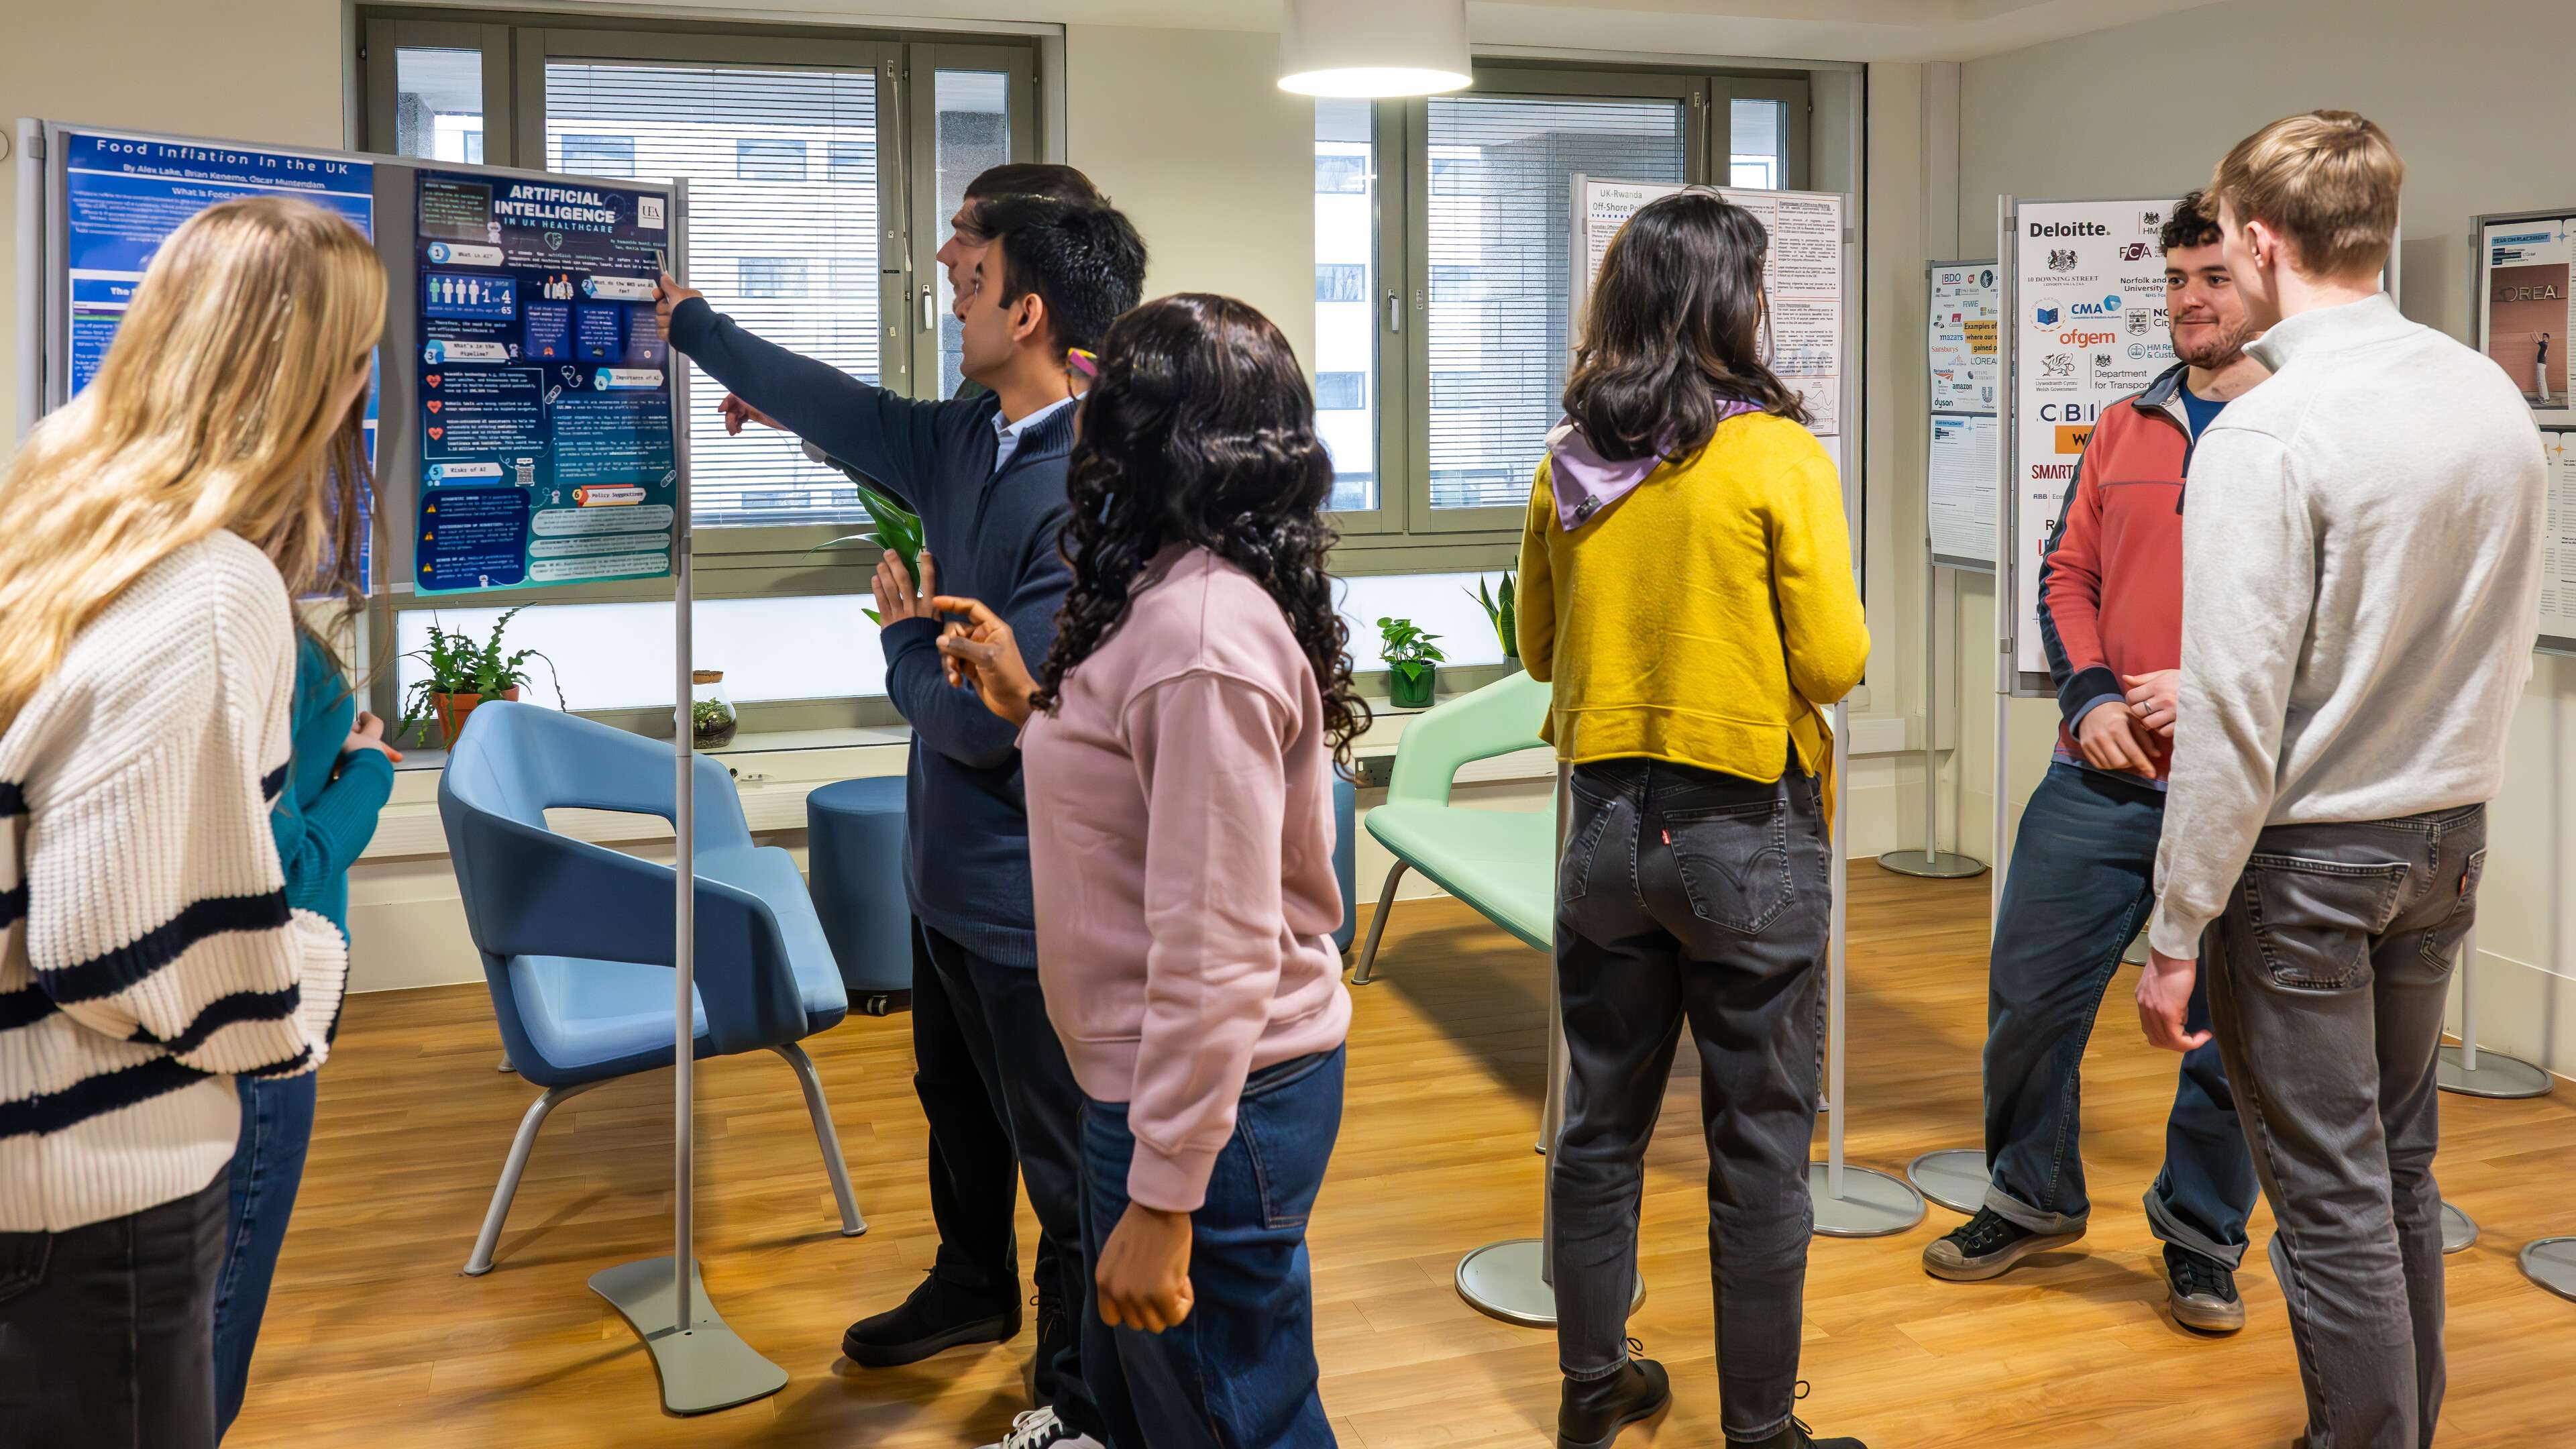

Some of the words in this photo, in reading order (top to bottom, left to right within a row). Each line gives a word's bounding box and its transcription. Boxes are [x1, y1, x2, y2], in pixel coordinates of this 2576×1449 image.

[97, 140, 148, 155] Food
[159, 146, 249, 165] Inflation
[260, 156, 276, 168] In
[286, 159, 316, 172] the
[326, 162, 348, 175] UK
[123, 163, 135, 174] By
[249, 175, 273, 184] Oscar
[172, 186, 197, 197] What
[509, 184, 602, 207] ARTIFICIAL
[1600, 189, 1642, 199] UK-Rwanda
[494, 200, 616, 223] INTELLIGENCE
[1593, 202, 1627, 211] Off-Shore
[504, 217, 516, 225] IN
[522, 218, 536, 227] UK
[542, 221, 613, 233] HEALTHCARE
[435, 249, 440, 257] 1
[2119, 246, 2152, 258] FCA
[1944, 273, 1962, 282] BDO
[584, 280, 589, 288] 2
[2125, 284, 2163, 292] University
[110, 286, 130, 296] The
[482, 288, 491, 303] 1
[501, 289, 512, 304] 4
[1963, 300, 1979, 308] RWE
[2072, 303, 2103, 314] CMA
[501, 306, 513, 315] 65
[1964, 323, 1990, 331] Examples
[2059, 328, 2116, 349] ofgem
[1974, 344, 1992, 353] gained
[427, 352, 433, 360] 3
[2094, 370, 2147, 380] Department
[2094, 381, 2106, 389] for
[2109, 381, 2151, 390] Transport
[1934, 397, 1953, 409] dyson
[433, 467, 439, 476] 5
